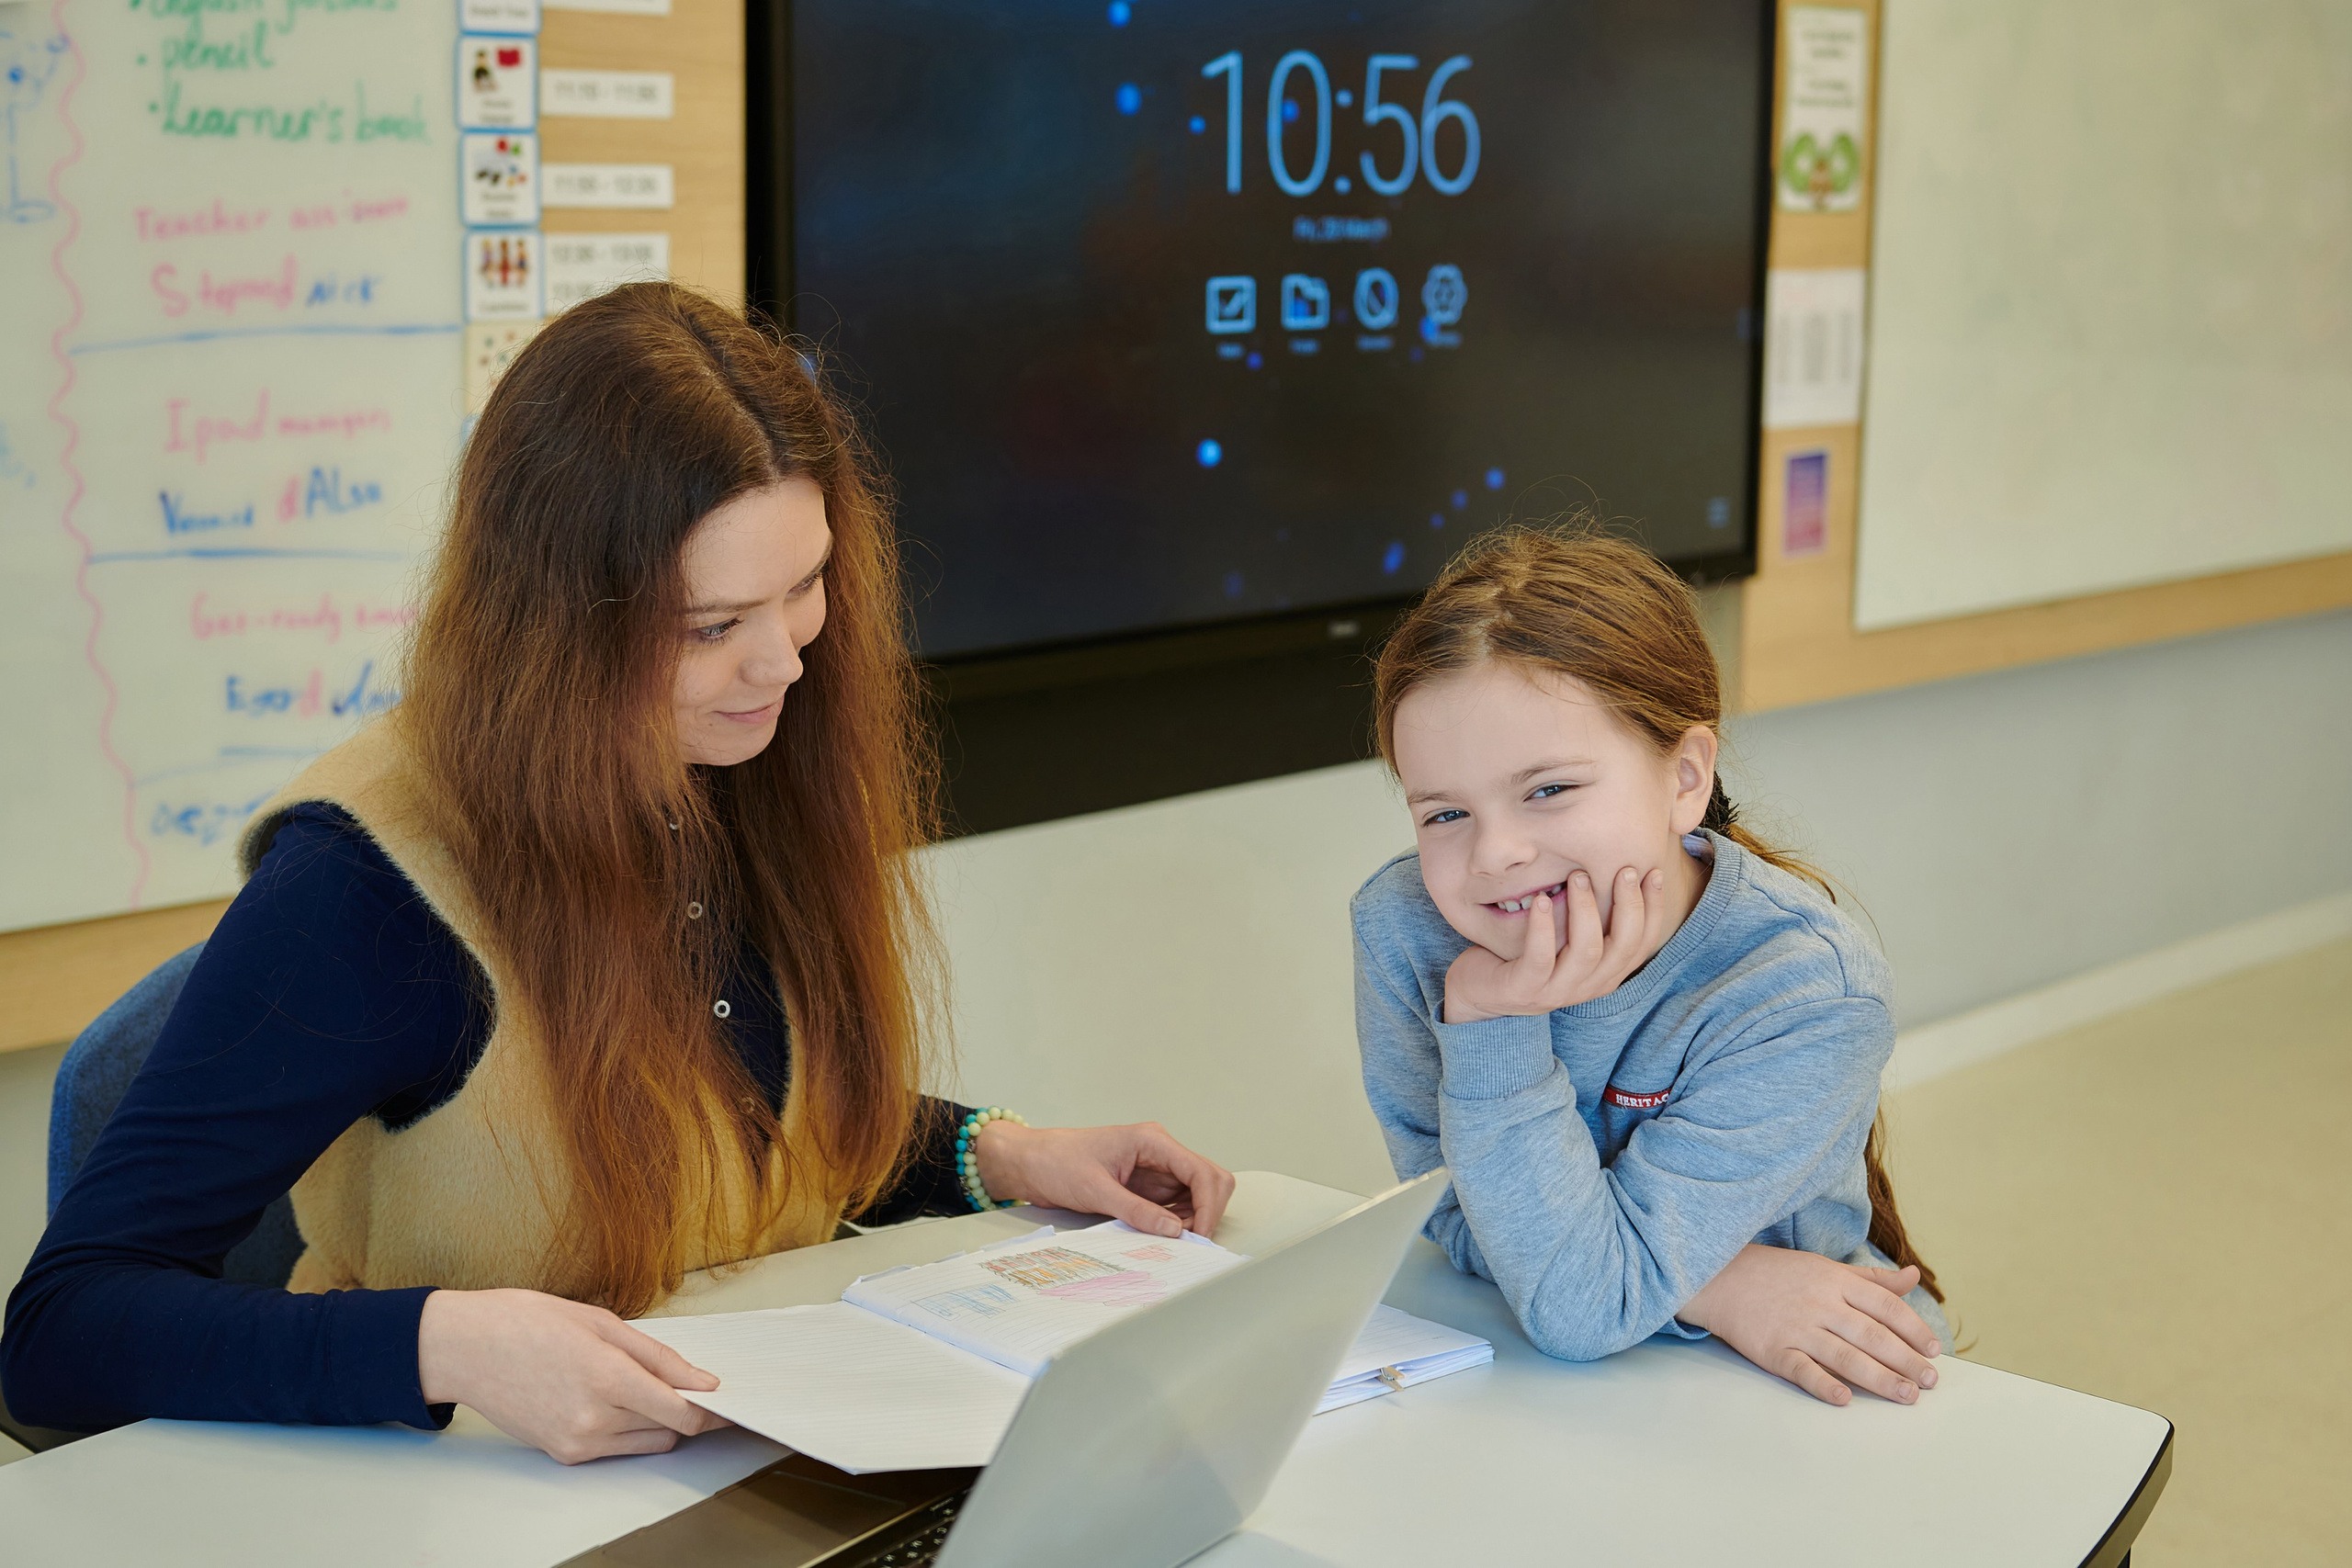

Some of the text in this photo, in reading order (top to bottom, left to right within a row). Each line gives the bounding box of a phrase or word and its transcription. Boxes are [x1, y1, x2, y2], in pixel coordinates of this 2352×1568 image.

[163, 19, 275, 85] pencil
[1202, 50, 1481, 197] 10:56
[134, 197, 269, 242] Teacher
